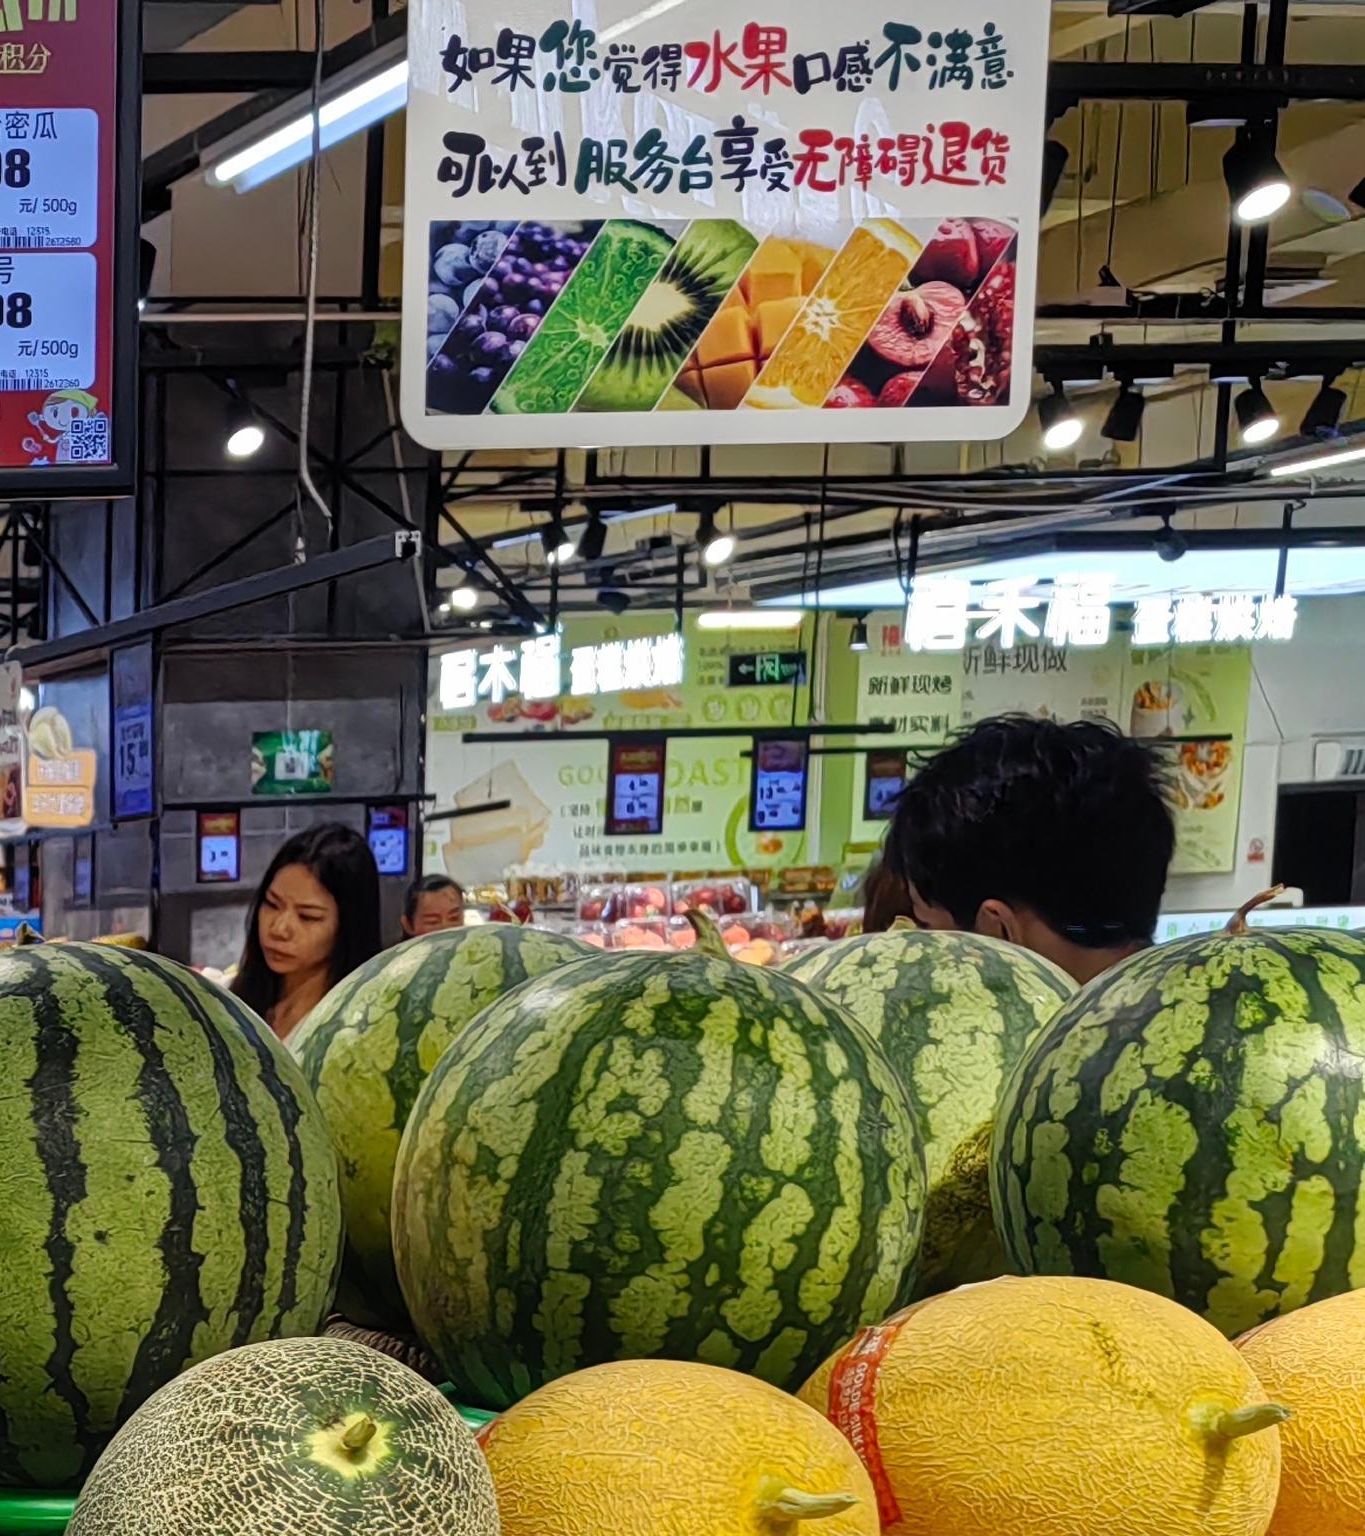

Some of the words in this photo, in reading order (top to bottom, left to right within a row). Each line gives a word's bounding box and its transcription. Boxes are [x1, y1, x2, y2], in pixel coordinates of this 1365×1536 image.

[441, 19, 1015, 94] 如果您觉得水果口感不满意
[438, 115, 1011, 197] 可以到服务台享受无障碍退货
[19, 197, 78, 215] 元/500g
[18, 339, 79, 358] 元/500g
[850, 1361, 869, 1410] GOLDE
